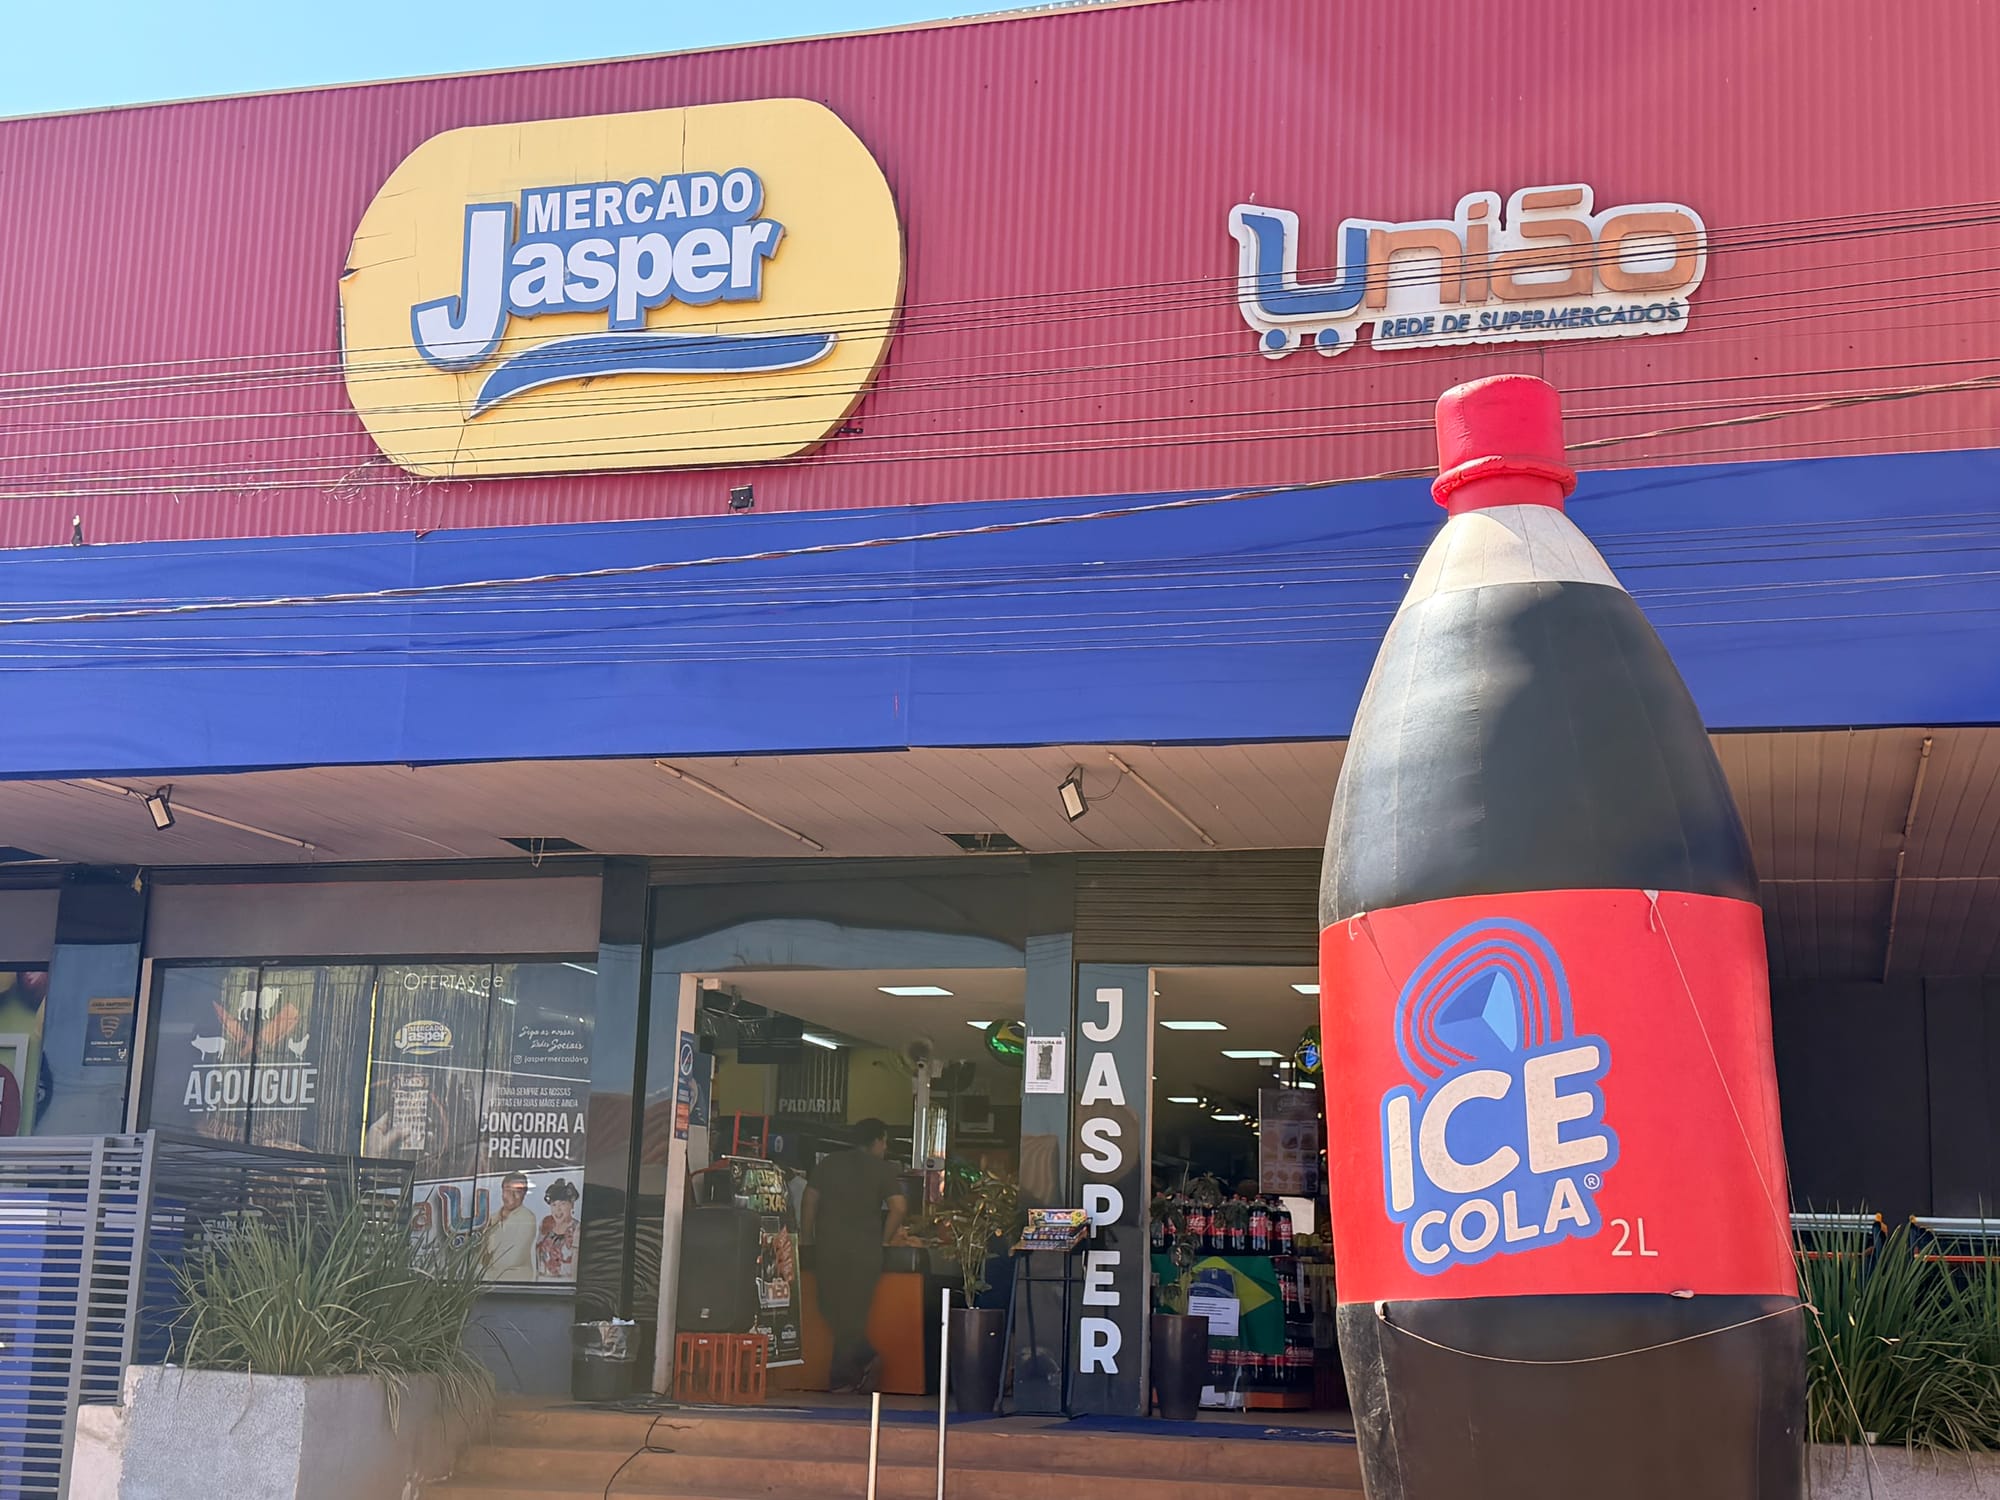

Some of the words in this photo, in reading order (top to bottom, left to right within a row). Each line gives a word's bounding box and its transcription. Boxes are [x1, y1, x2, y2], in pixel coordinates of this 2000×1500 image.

[526, 171, 754, 234] MERCADO
[417, 210, 772, 361] Jasper
[1381, 315, 1435, 338] REDE
[1441, 313, 1471, 333] DE
[1478, 301, 1681, 332] SUPERMERCADOS
[403, 973, 475, 991] OFERTAS
[394, 1027, 448, 1049] Jasper
[183, 1068, 318, 1112] AÇOUGUE
[778, 1098, 842, 1113] PADARIA
[480, 1111, 569, 1134] CONCORRA
[573, 1112, 585, 1134] A
[1387, 1045, 1608, 1212] ICE
[487, 1134, 571, 1159] PRÊMIOS!
[1080, 988, 1126, 1374] JASPER
[1410, 1177, 1591, 1264] COLA
[1610, 1217, 1659, 1257] 2L
